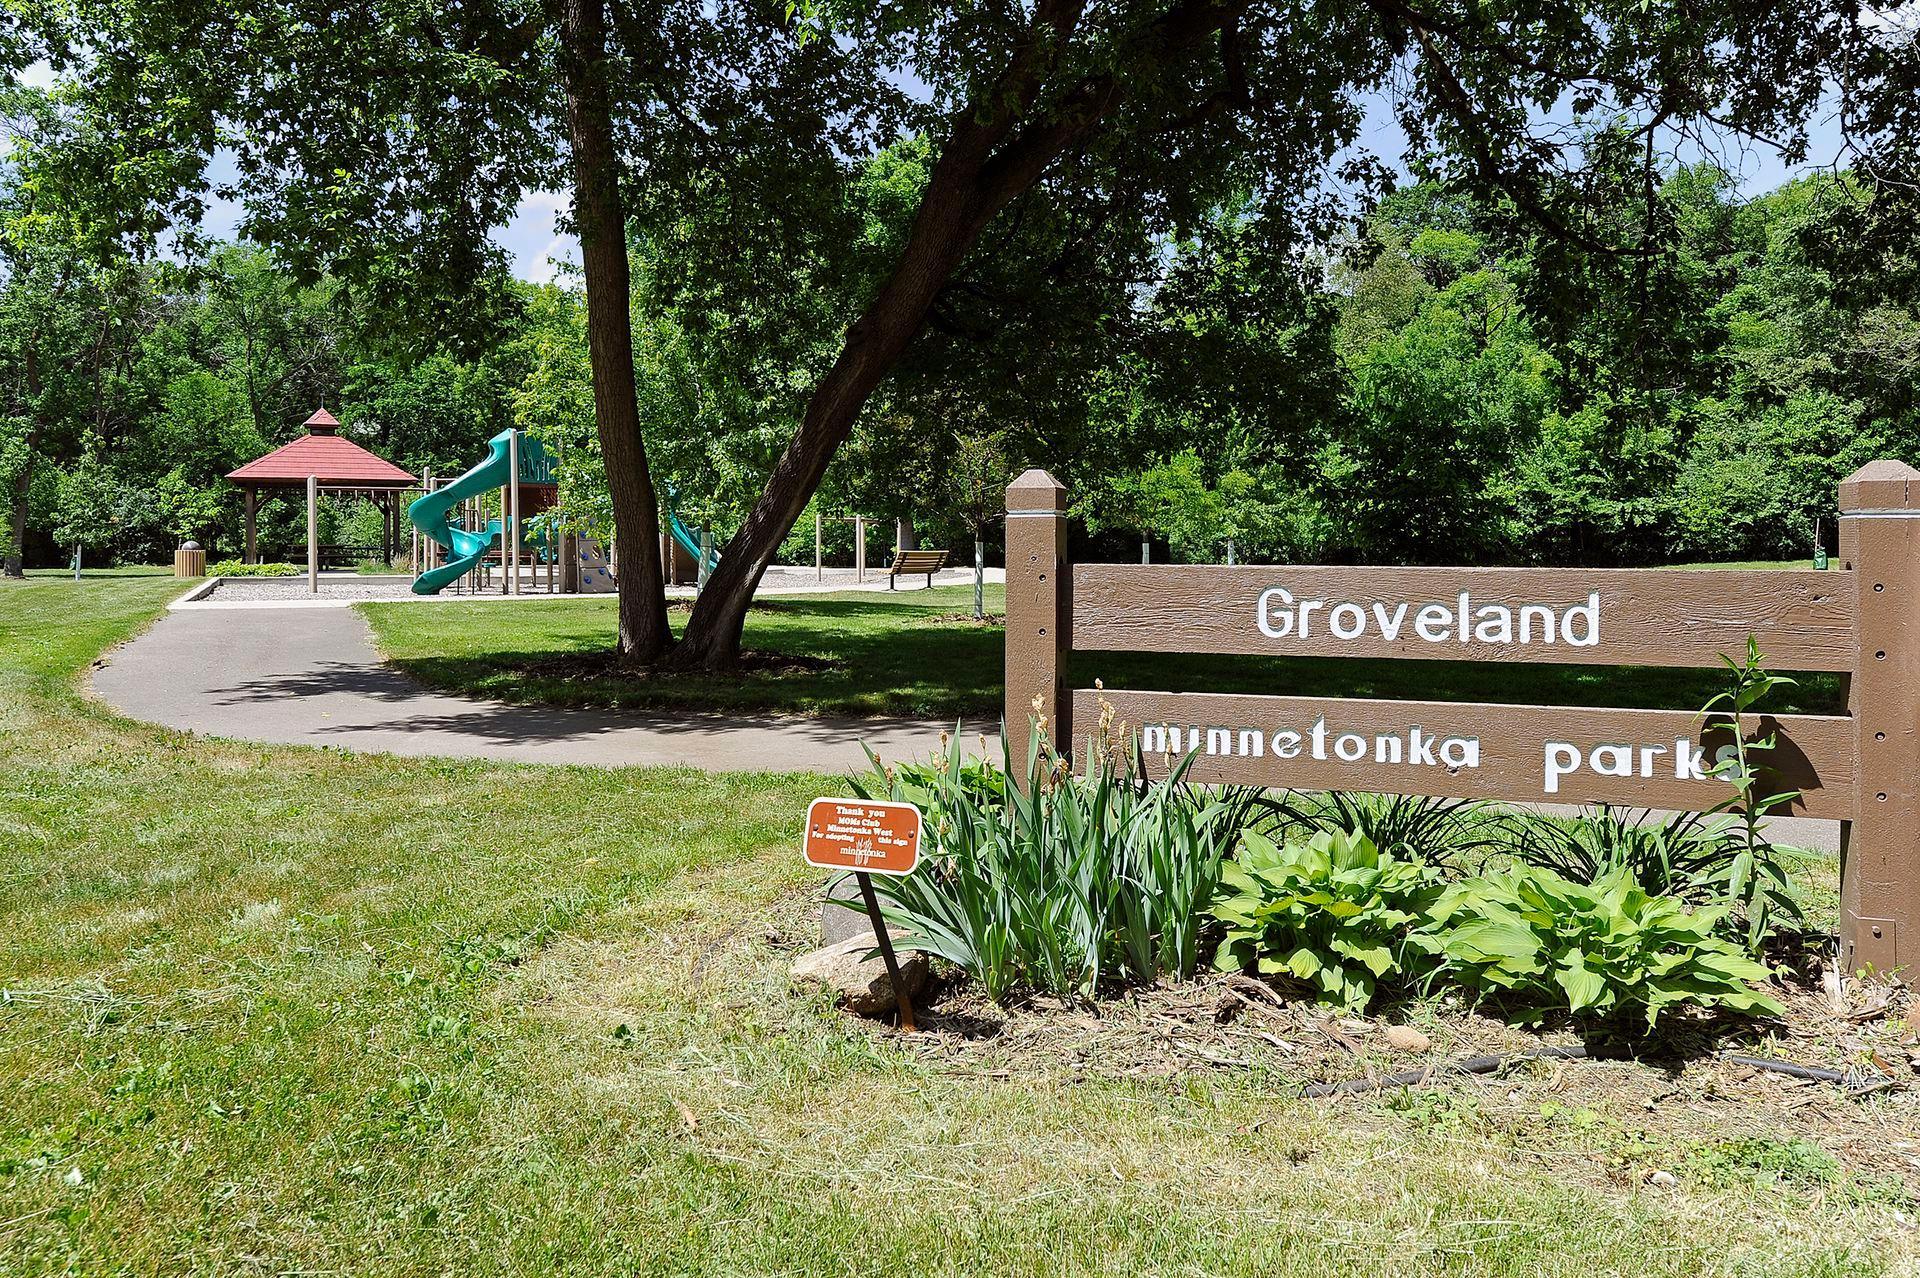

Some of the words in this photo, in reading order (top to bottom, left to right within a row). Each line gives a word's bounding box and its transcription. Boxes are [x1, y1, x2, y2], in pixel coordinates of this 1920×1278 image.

[1257, 586, 1600, 646] Groveland
[1143, 715, 1480, 769] minnetonka
[836, 805, 865, 816] Thank
[868, 809, 885, 818] you
[838, 817, 861, 826] MOMs
[861, 818, 880, 827] Club
[827, 824, 872, 835] Minnetonka
[873, 828, 893, 836] West
[825, 833, 854, 842] adopting
[893, 838, 908, 847] sign
[840, 846, 886, 858] minnetonka
